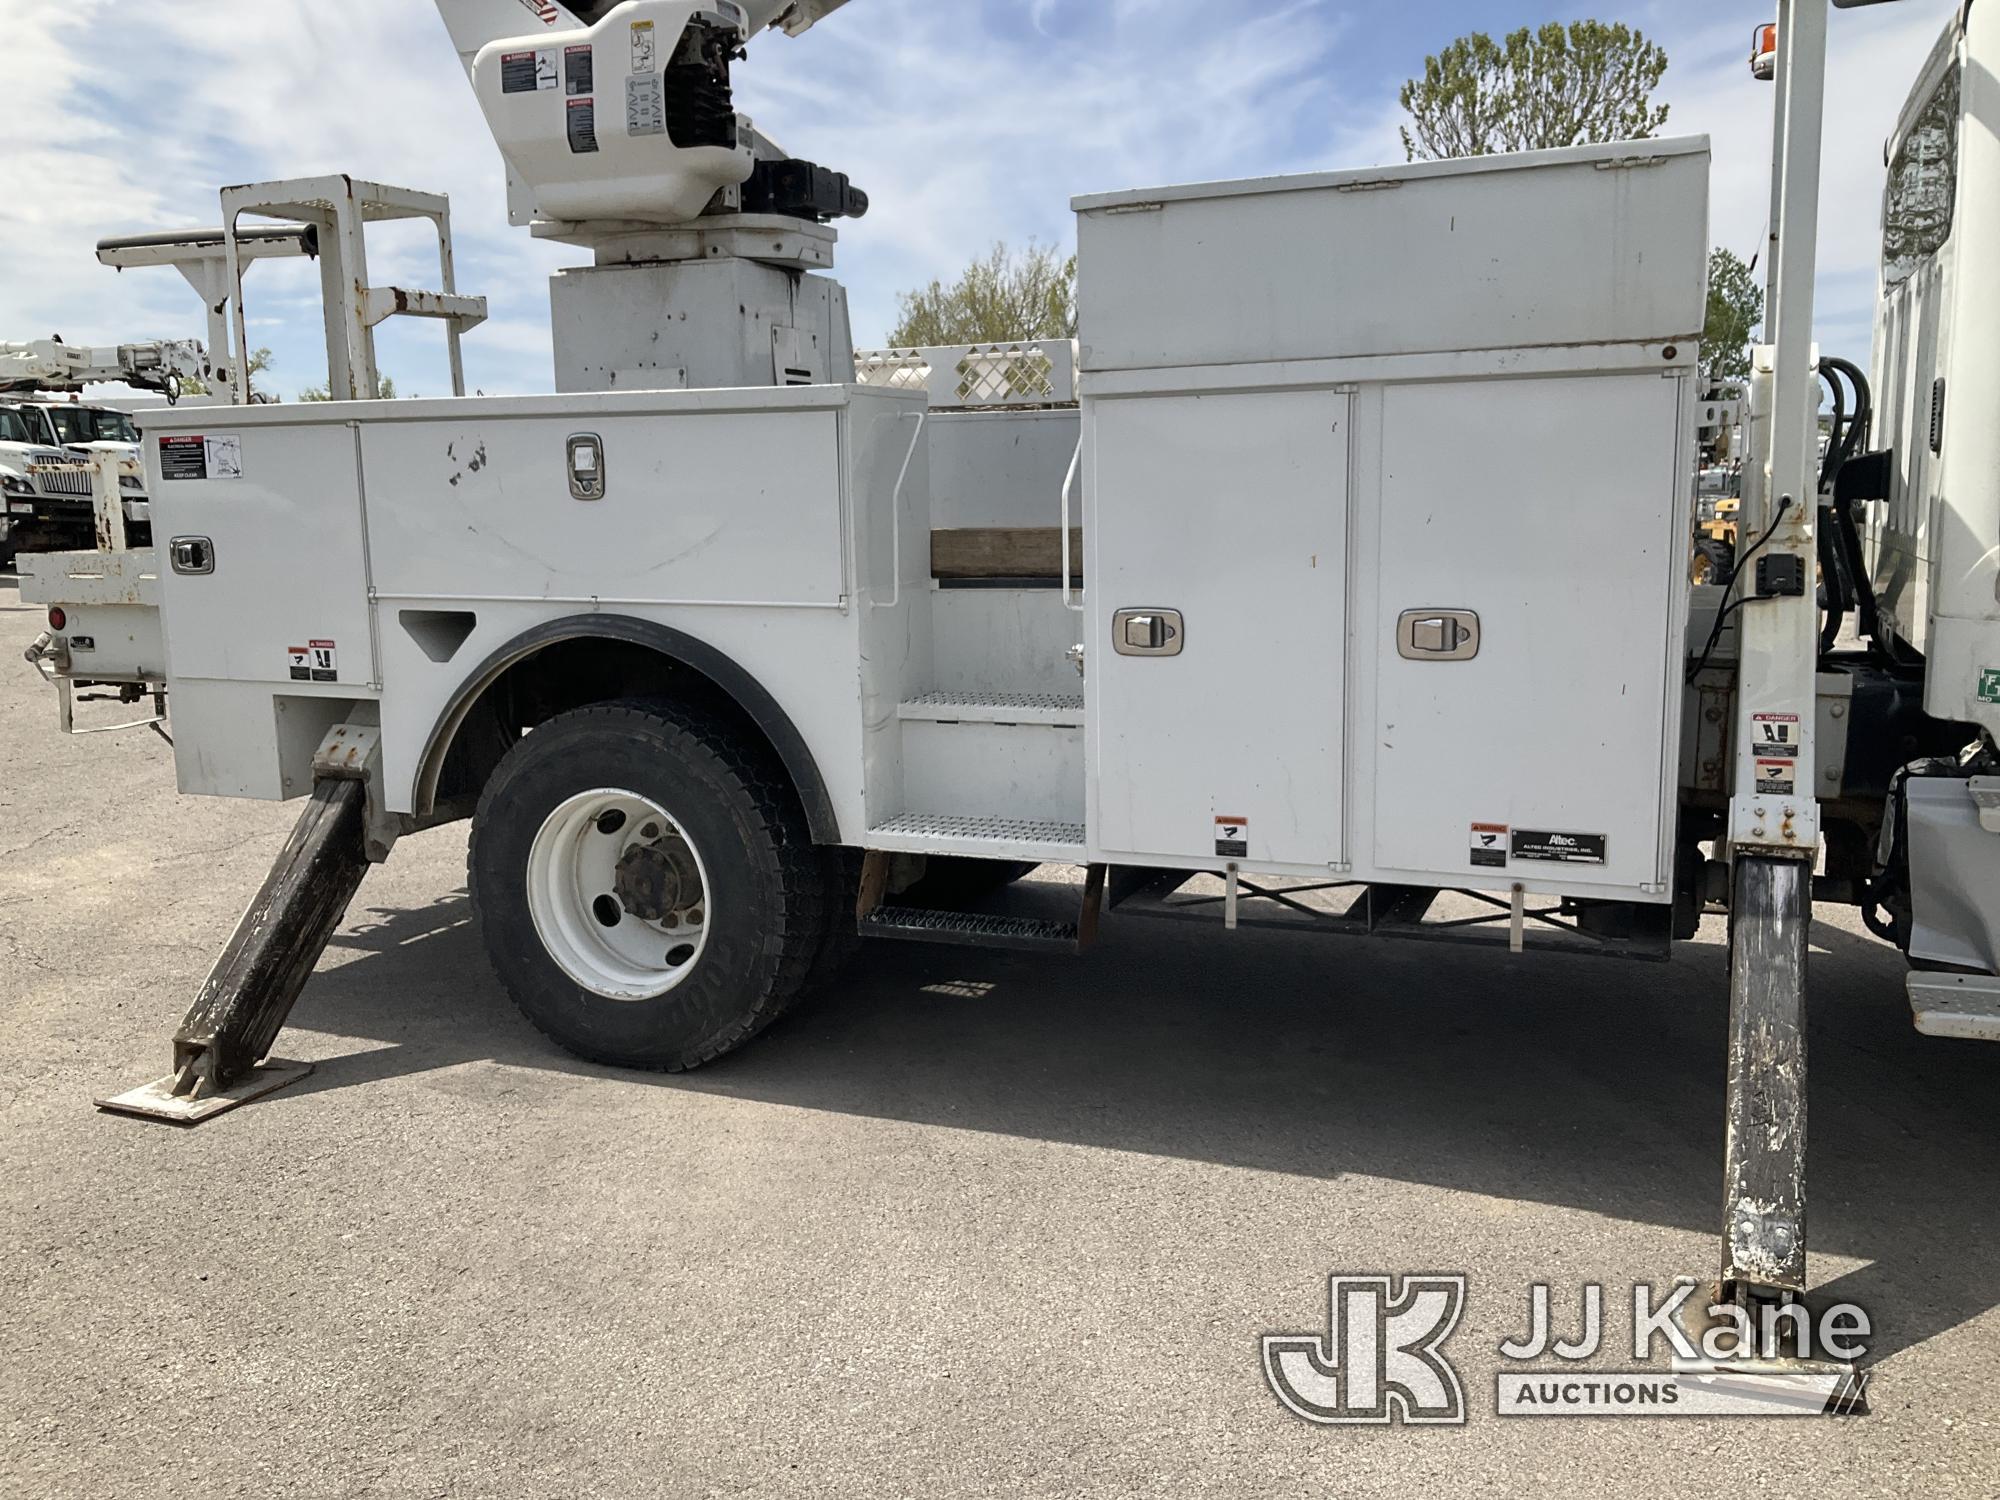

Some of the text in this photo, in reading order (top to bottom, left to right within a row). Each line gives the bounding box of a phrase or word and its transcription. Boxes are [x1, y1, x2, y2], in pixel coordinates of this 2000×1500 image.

[570, 45, 591, 53] DANGER
[511, 52, 531, 60] DANGER
[1548, 834, 1576, 846] Altec
